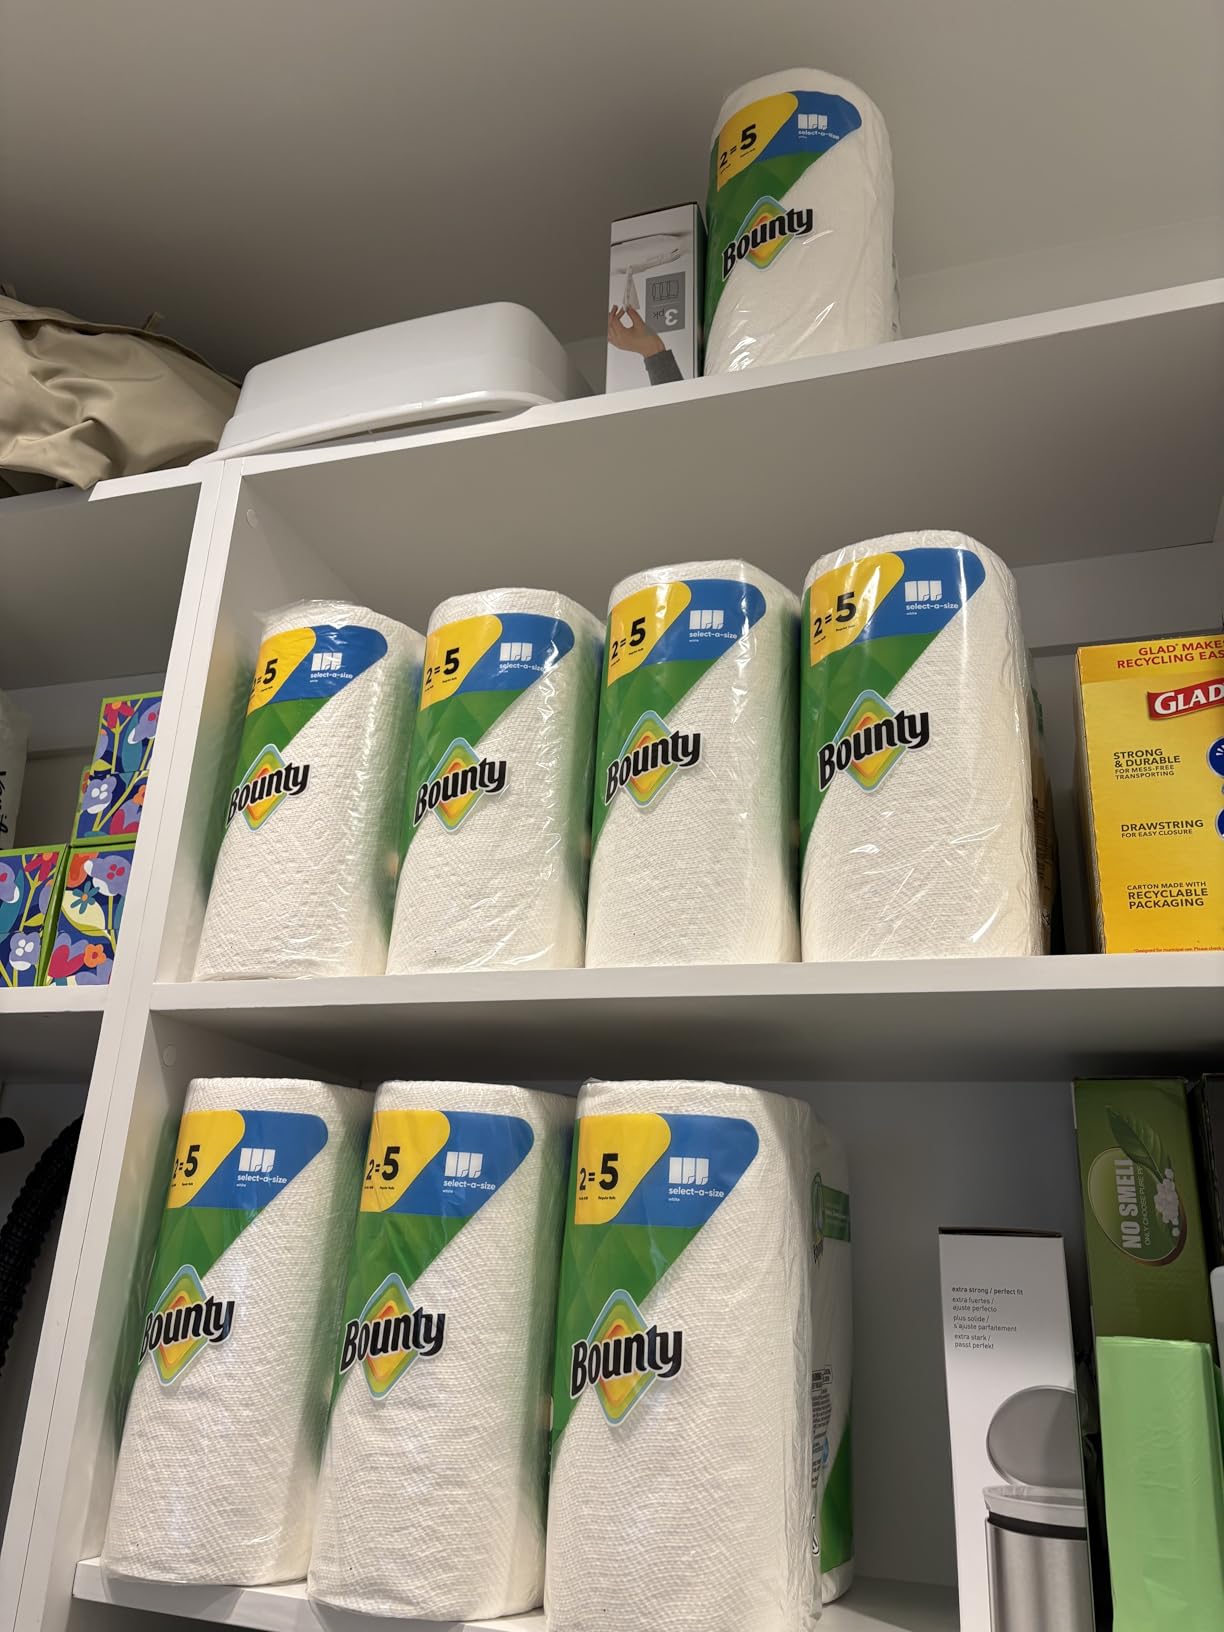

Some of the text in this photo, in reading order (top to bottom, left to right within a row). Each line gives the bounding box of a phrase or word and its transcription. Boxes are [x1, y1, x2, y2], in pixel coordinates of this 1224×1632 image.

[722, 207, 813, 280] Bounty
[906, 602, 959, 611] select-a-size
[689, 630, 737, 639] select-a-size
[1138, 640, 1224, 656] GLAD MAKE
[499, 662, 545, 672] select-a-size
[1117, 653, 1194, 669] RECYCLING
[310, 671, 353, 680] select-a-size
[1154, 683, 1224, 715] GLAD
[818, 710, 930, 791] Bounty
[1113, 748, 1163, 760] STRONG
[605, 730, 701, 805] Bounty
[1114, 755, 1181, 768] & DURABLE
[1132, 765, 1175, 773] MESS-FREE
[1115, 771, 1175, 780] TRANSPORTING
[226, 763, 310, 828] Bounty
[414, 758, 507, 827] Bounty
[1121, 819, 1204, 832] DRAWSTRING
[1127, 883, 1159, 891] CARTON
[1128, 888, 1209, 900] RECYCLABLE
[1129, 898, 1204, 909] PACKAGING
[237, 1173, 288, 1184] select-a-size
[443, 1179, 496, 1191] select-a-size
[668, 1187, 725, 1198] select-a-size
[1114, 1159, 1142, 1249] NO SMELL
[1143, 1225, 1151, 1246] ONLY
[968, 1287, 989, 1295] strong
[139, 1296, 235, 1365] Bounty
[978, 1324, 1017, 1332] parfaitement
[340, 1307, 446, 1374] Bounty
[571, 1324, 683, 1399] Bounty
